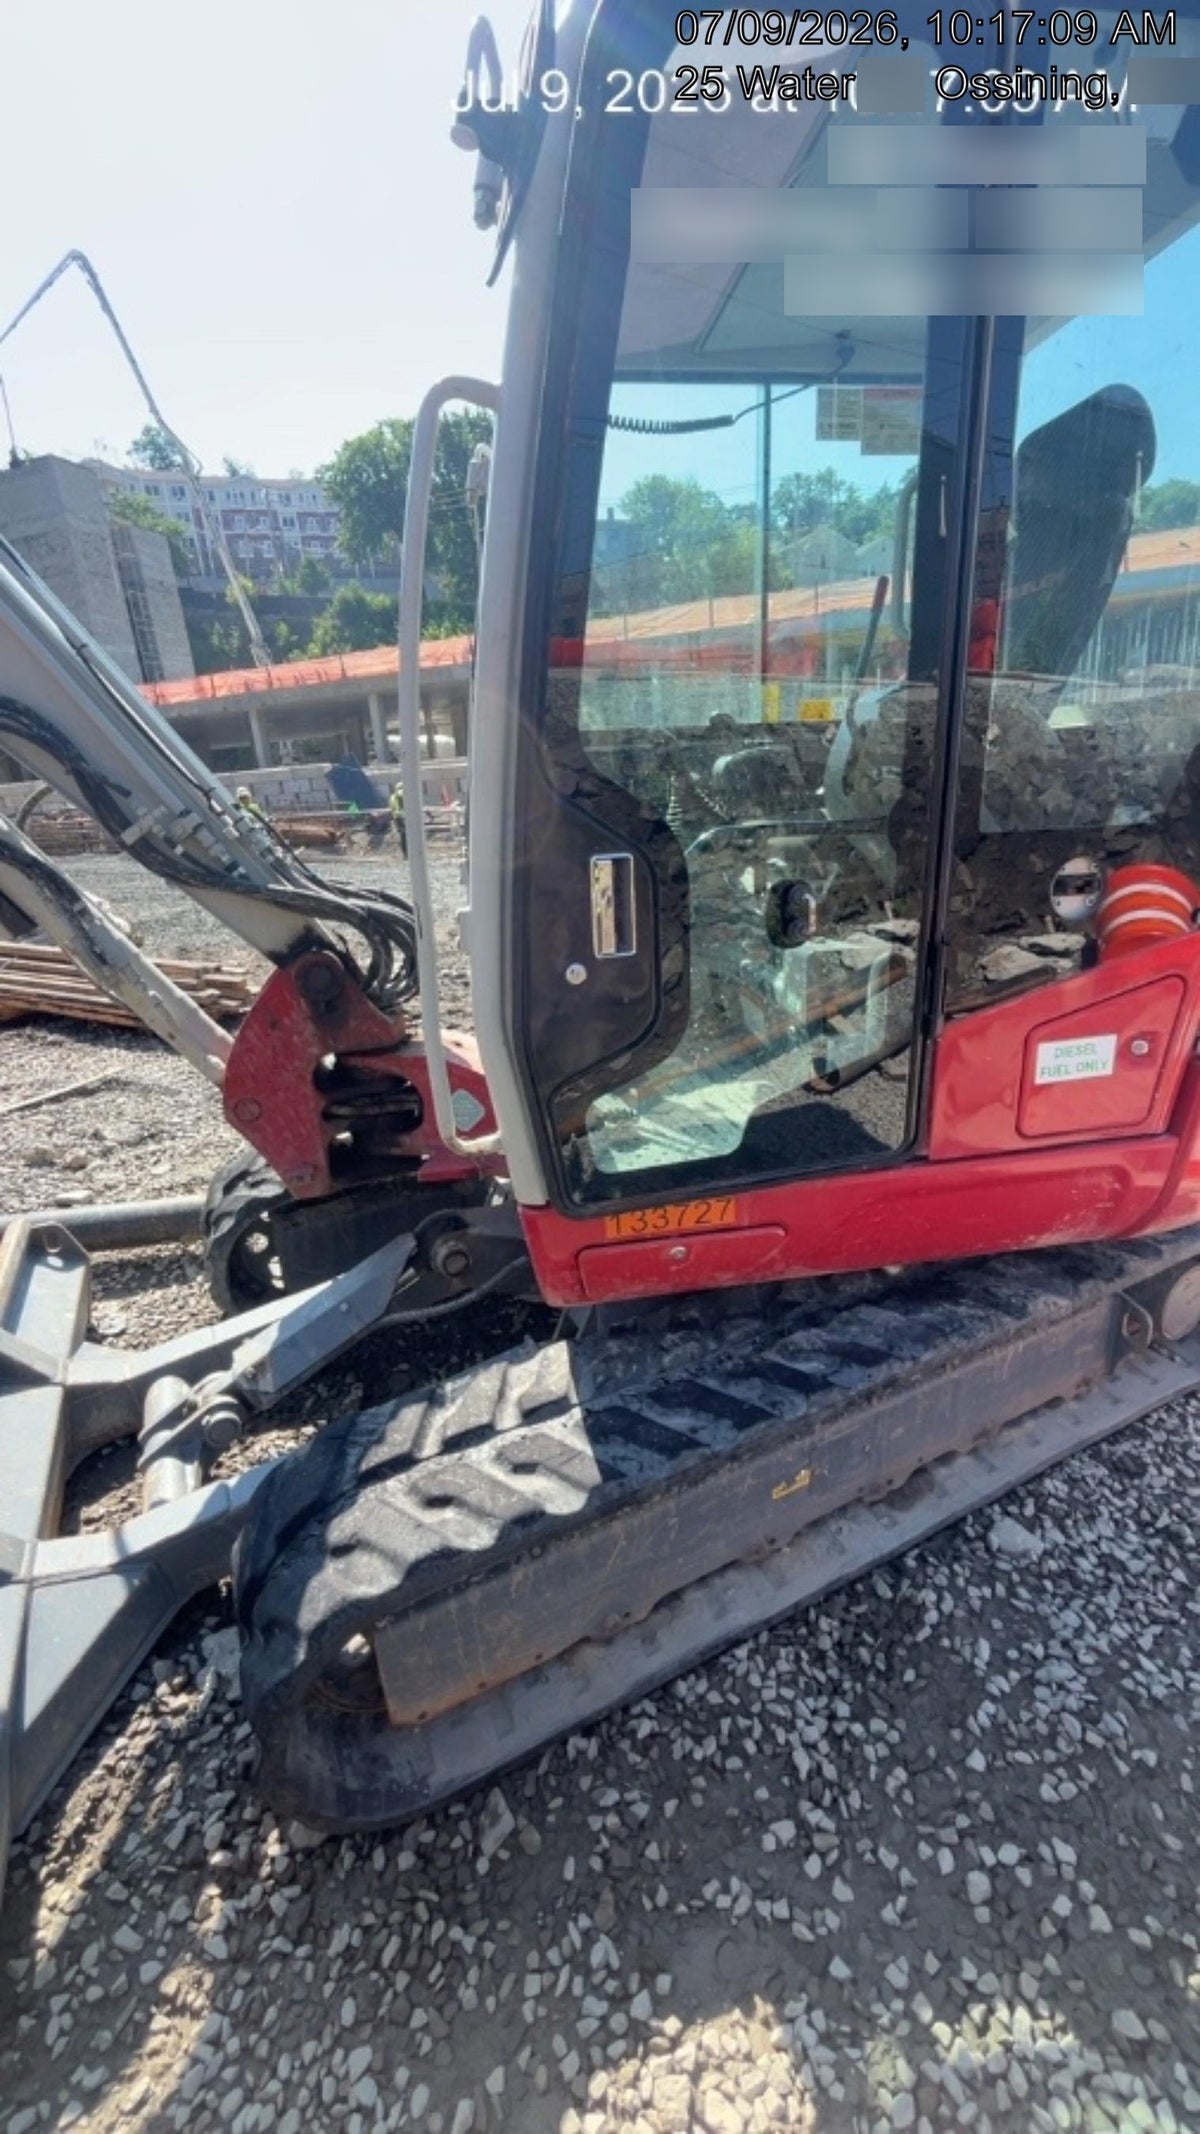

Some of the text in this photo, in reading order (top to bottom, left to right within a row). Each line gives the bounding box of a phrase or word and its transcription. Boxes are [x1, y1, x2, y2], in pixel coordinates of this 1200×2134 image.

[1055, 1042, 1097, 1058] DIESEL
[1040, 1059, 1109, 1078] FUEL ONLY
